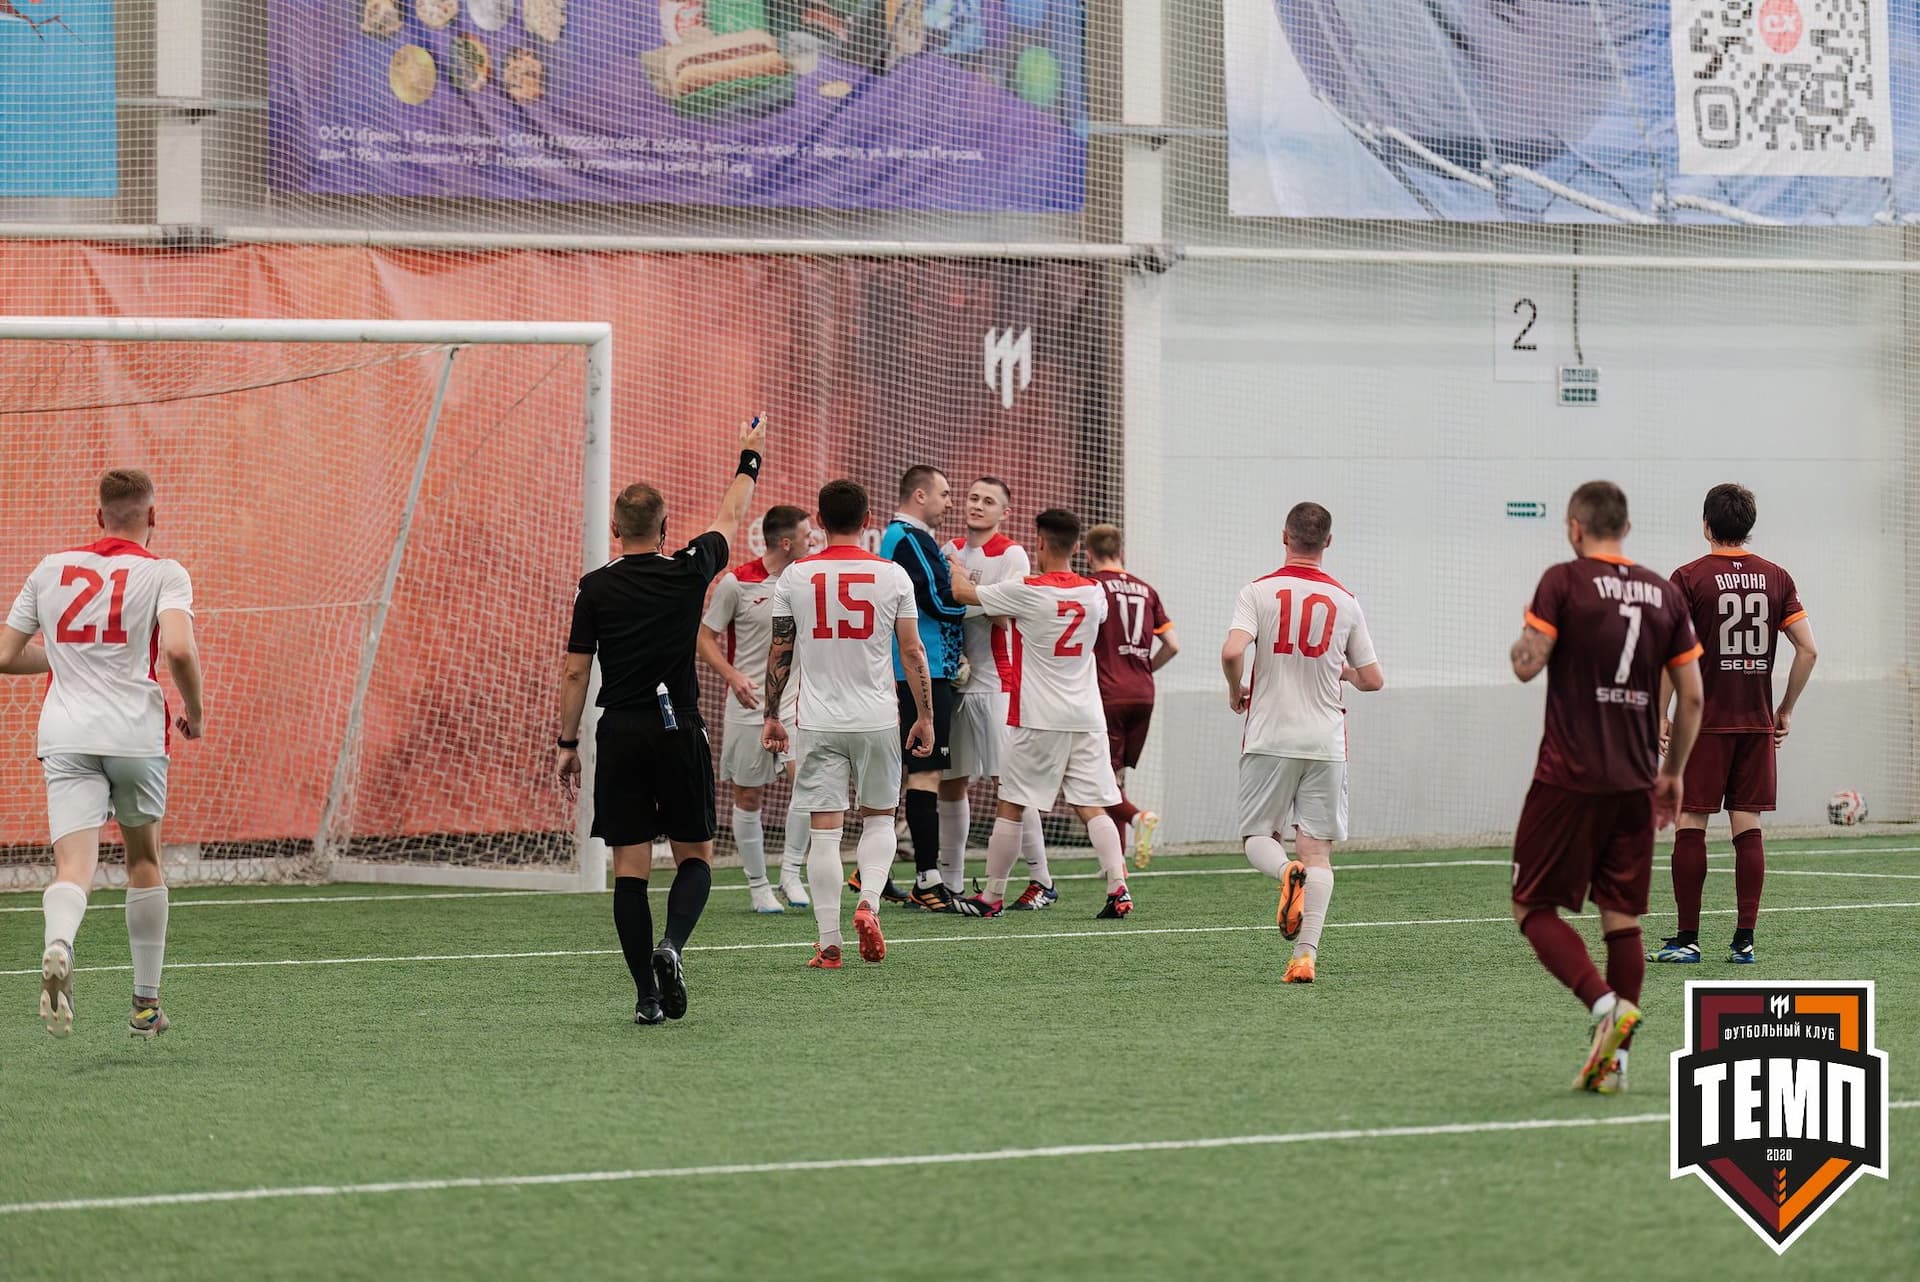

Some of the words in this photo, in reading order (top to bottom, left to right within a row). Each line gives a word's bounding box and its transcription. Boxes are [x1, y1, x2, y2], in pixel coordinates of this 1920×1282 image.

[319, 126, 353, 141] ООО
[508, 133, 545, 148] ОГРН
[1513, 297, 1537, 350] 2
[56, 564, 130, 644] 21
[811, 572, 875, 640] 15
[1715, 573, 1766, 590] ВОРОНА
[1054, 600, 1086, 657] 2
[1116, 593, 1146, 645] 17
[1273, 588, 1338, 658] 10
[1614, 604, 1641, 684] 7
[1718, 593, 1769, 655] 23
[1720, 659, 1768, 671] SEUS
[1596, 687, 1649, 705] SEUS
